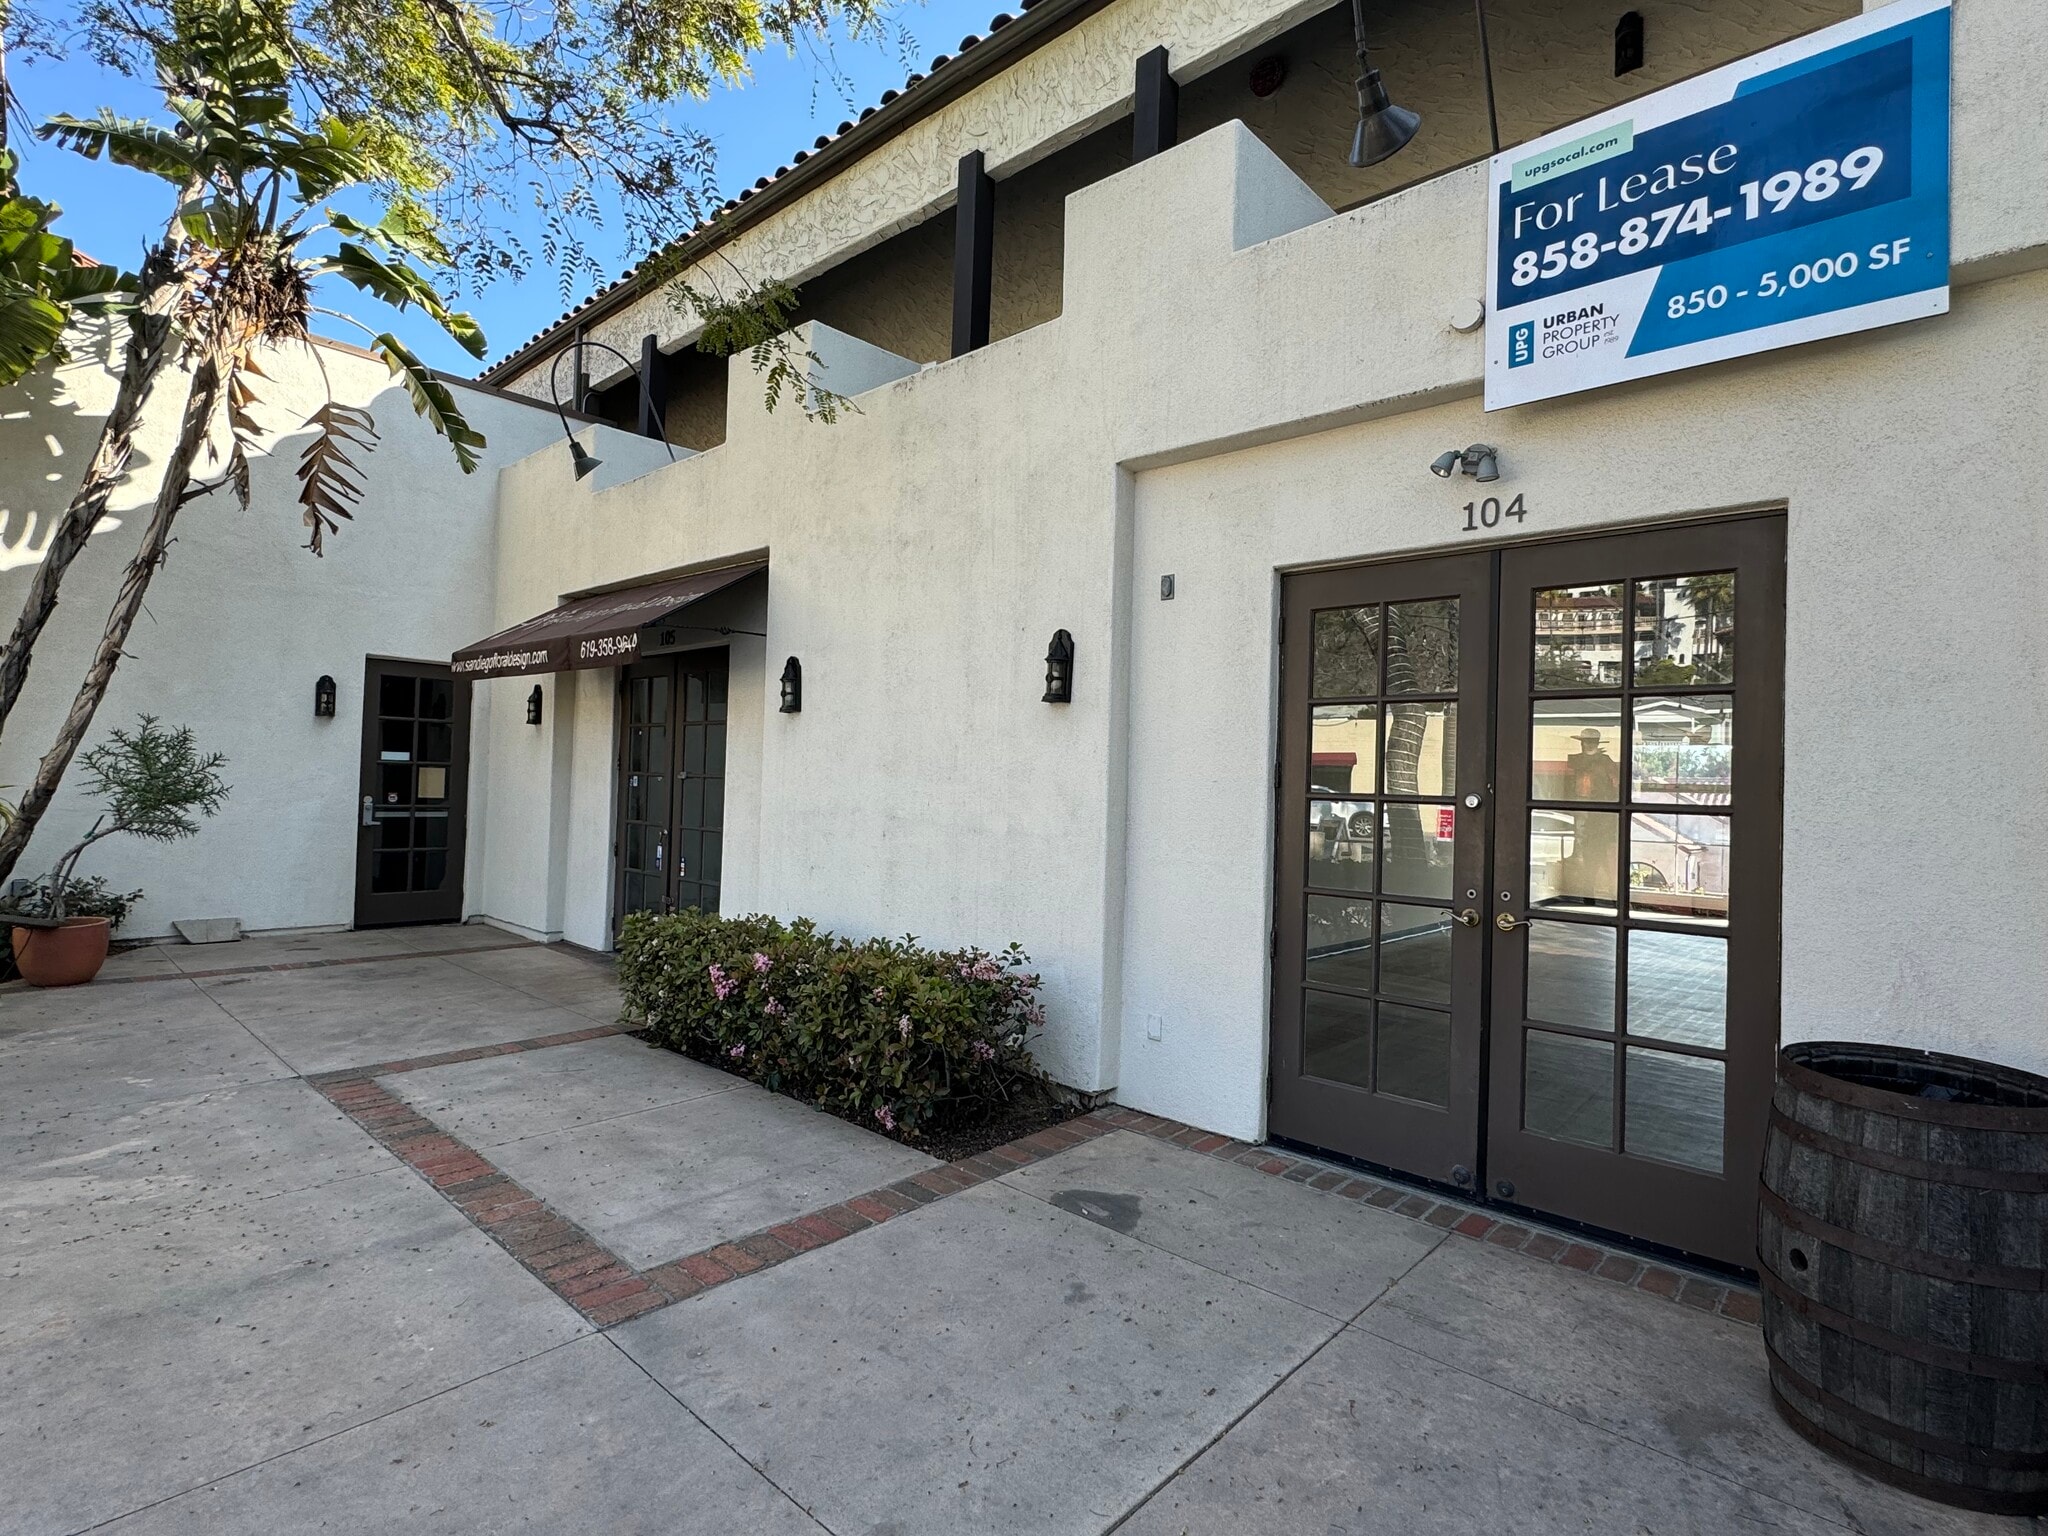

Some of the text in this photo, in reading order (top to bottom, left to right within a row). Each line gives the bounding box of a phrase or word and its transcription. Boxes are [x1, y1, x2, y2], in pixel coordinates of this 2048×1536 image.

[1525, 136, 1618, 177] upgsocal.com
[1514, 144, 1737, 239] For Lease
[1511, 146, 1884, 287] 858-874-1989
[1667, 237, 1910, 319] 850 - 5,000 SF
[1543, 303, 1603, 329] URBAN
[1543, 314, 1619, 344] PROPERTY
[1515, 327, 1529, 362] UPG
[1542, 334, 1600, 359] GROUP
[1462, 493, 1527, 531] 104
[660, 630, 676, 646] 105
